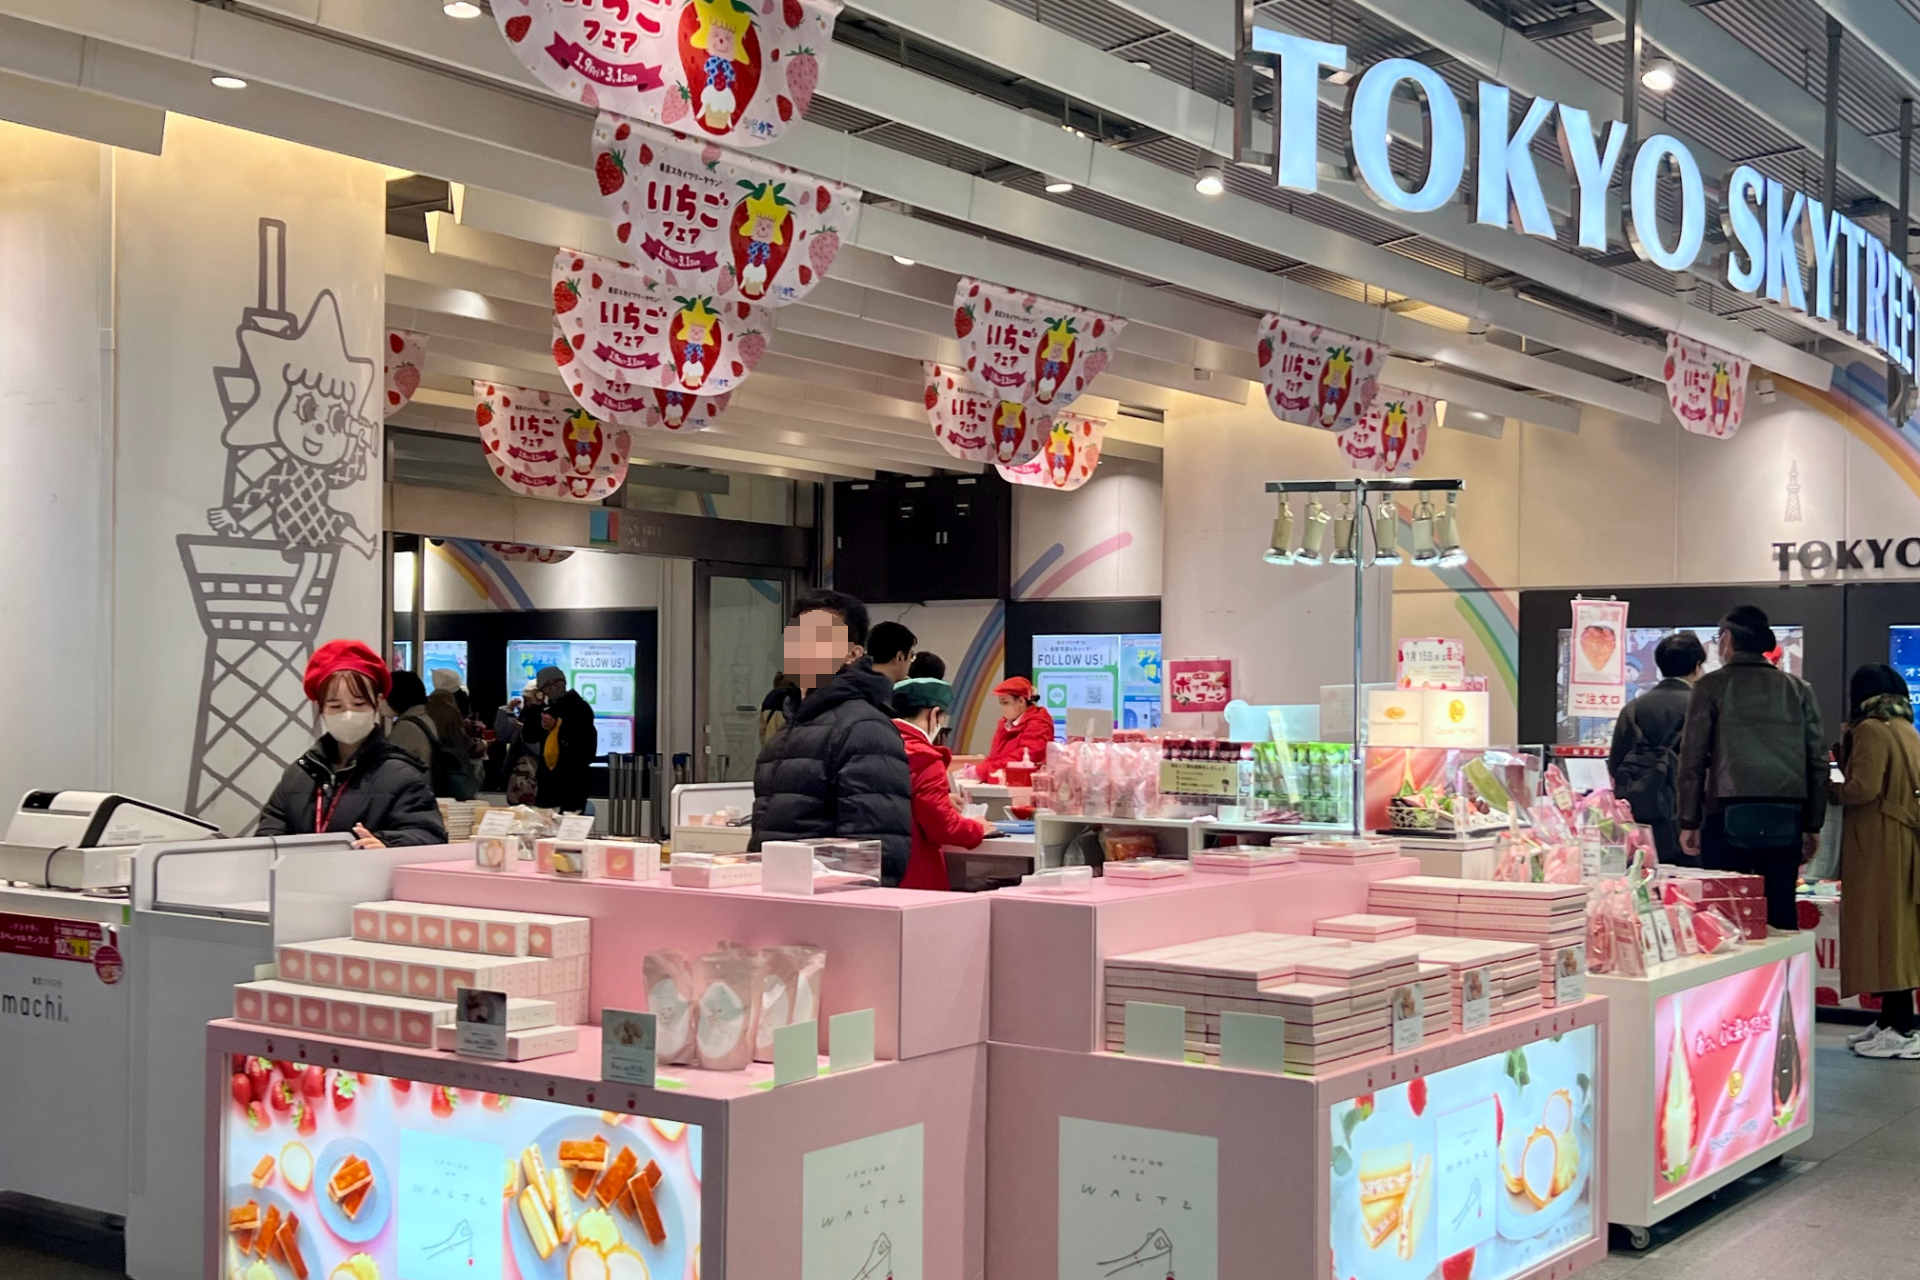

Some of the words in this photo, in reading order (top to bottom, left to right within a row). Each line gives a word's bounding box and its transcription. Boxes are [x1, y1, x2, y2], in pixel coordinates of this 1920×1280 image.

[583, 20, 638, 53] フェア
[1252, 25, 1706, 271] TOKYO
[648, 181, 729, 228] いちご
[663, 221, 701, 245] フェア
[600, 301, 667, 335] いちご
[613, 331, 644, 348] フェア
[986, 324, 1038, 355] いちご
[1281, 353, 1321, 381] いちご
[952, 398, 992, 422] いちご
[510, 414, 560, 437] いちご
[1772, 537, 1920, 571] TOKYO
[575, 658, 609, 668] FOLLOW
[610, 658, 626, 668] US!
[1038, 654, 1082, 665] FOLLOW
[1085, 654, 1103, 665] US!
[1574, 693, 1620, 705] ご注文口
[1081, 1183, 1192, 1211] WALTZ
[820, 1194, 906, 1229] WALTZ
